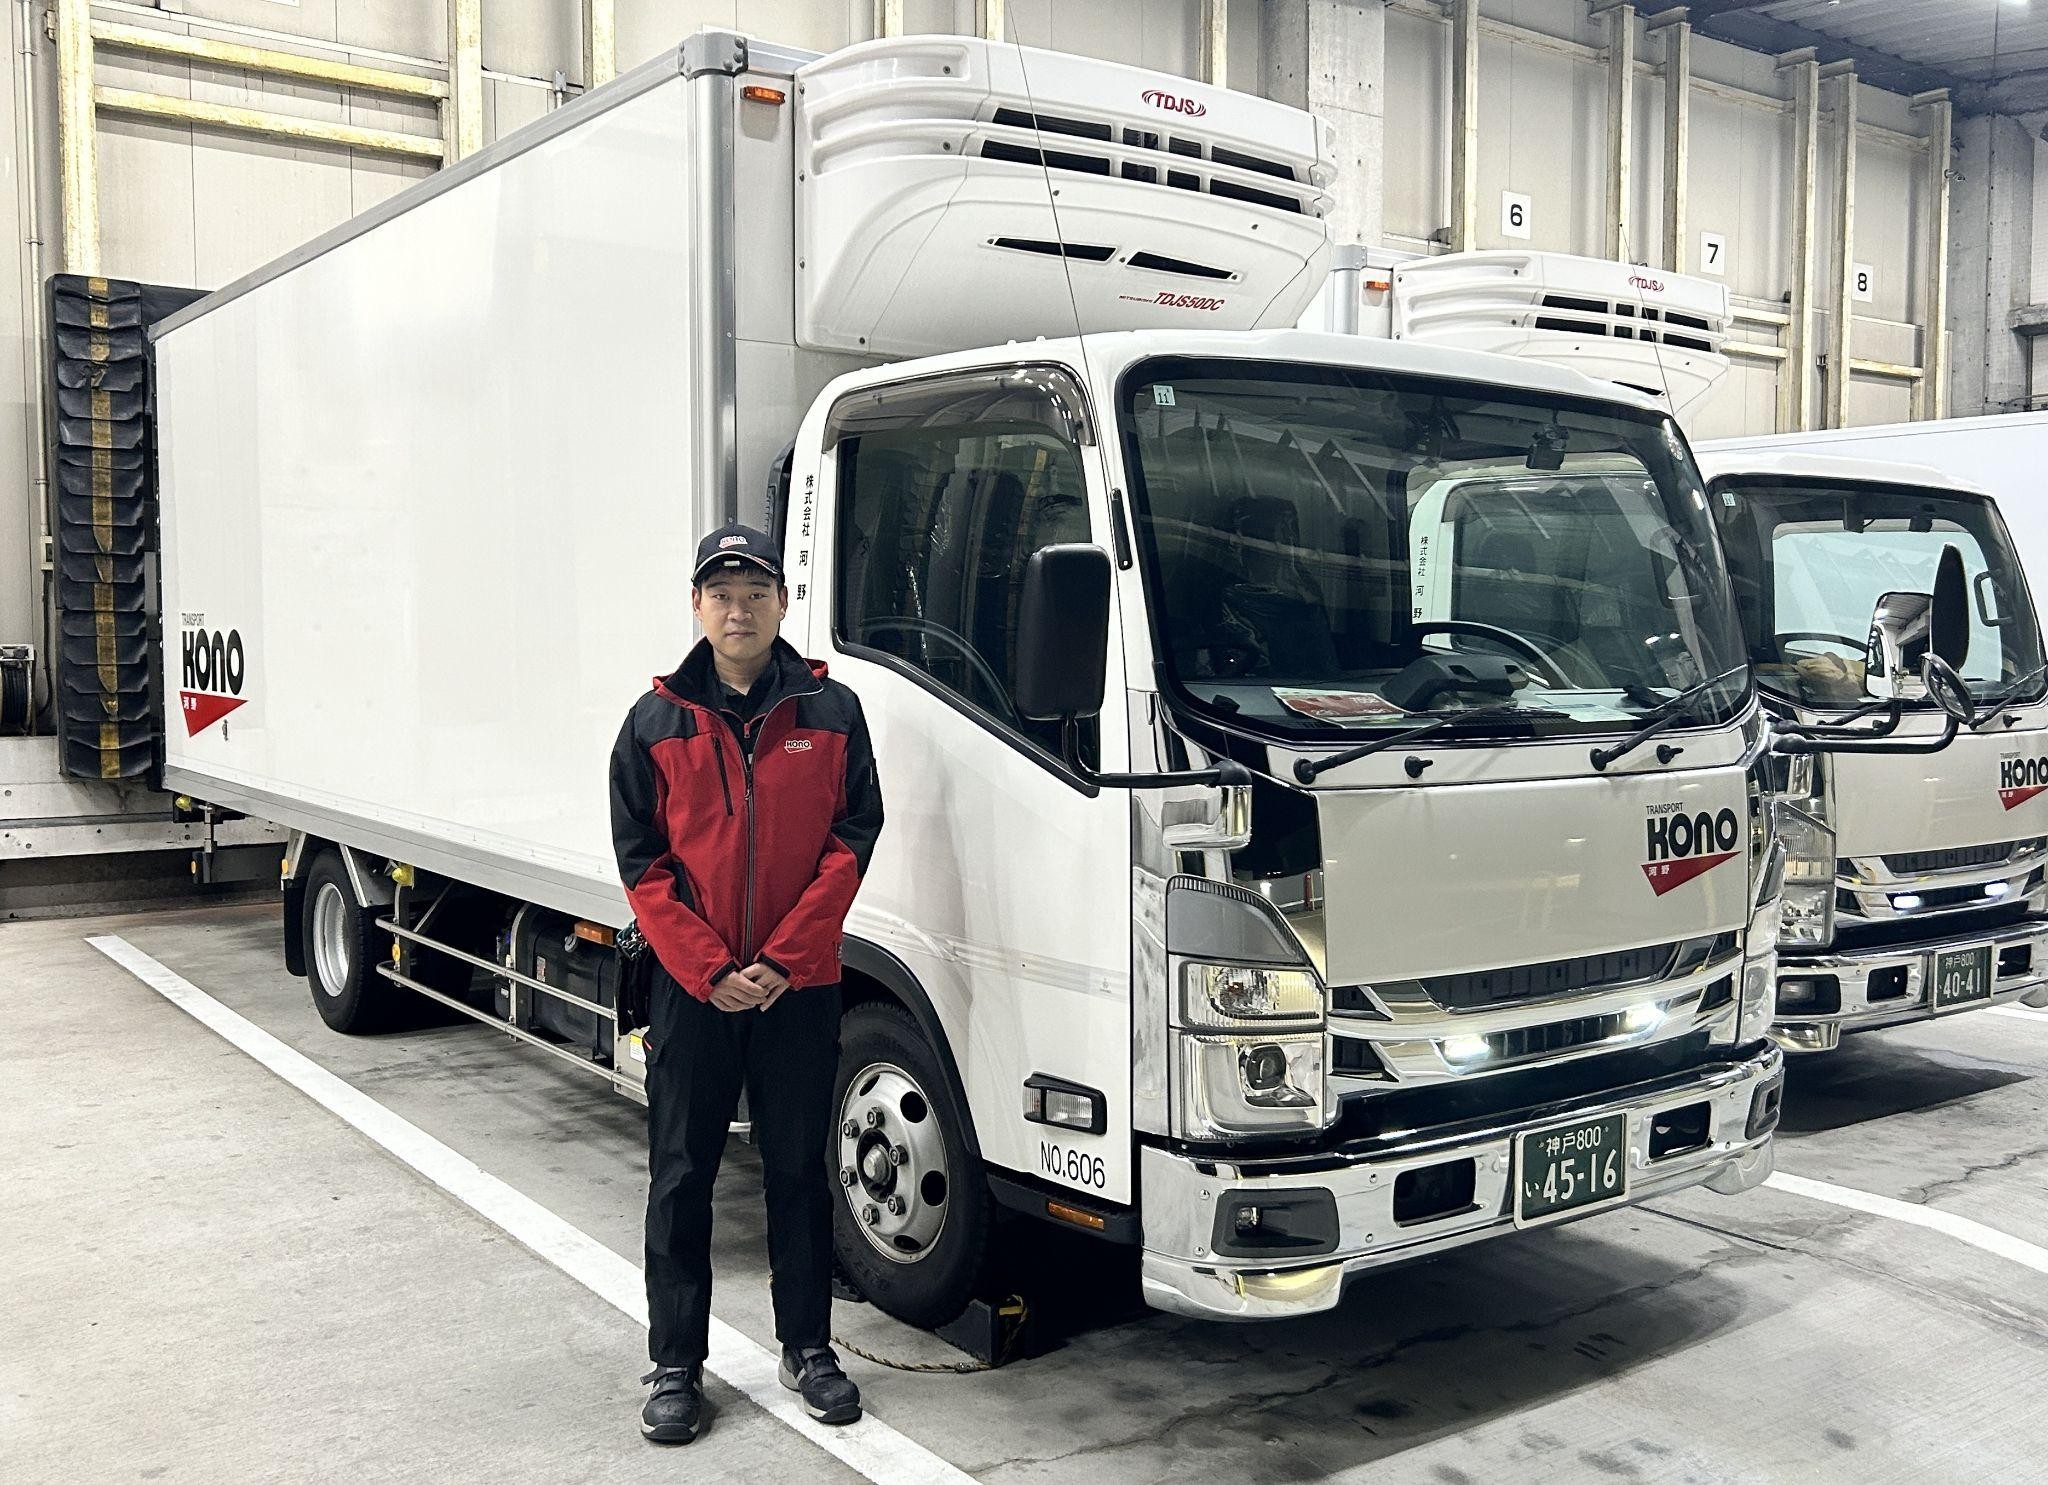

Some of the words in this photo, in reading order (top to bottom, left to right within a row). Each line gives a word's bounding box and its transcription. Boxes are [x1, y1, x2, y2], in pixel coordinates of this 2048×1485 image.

[1153, 92, 1195, 115] TDJS
[1510, 203, 1523, 227] 6
[1707, 242, 1719, 264] 7
[1636, 277, 1658, 291] TDJS
[1857, 272, 1868, 292] 8
[1153, 292, 1225, 311] TDJS50DC
[1646, 802, 1684, 815] TRANSPORT
[1943, 967, 1981, 999] 40-41
[1041, 1140, 1106, 1189] NO.606
[1525, 1181, 1540, 1198] い
[1543, 1148, 1617, 1204] 45-16
